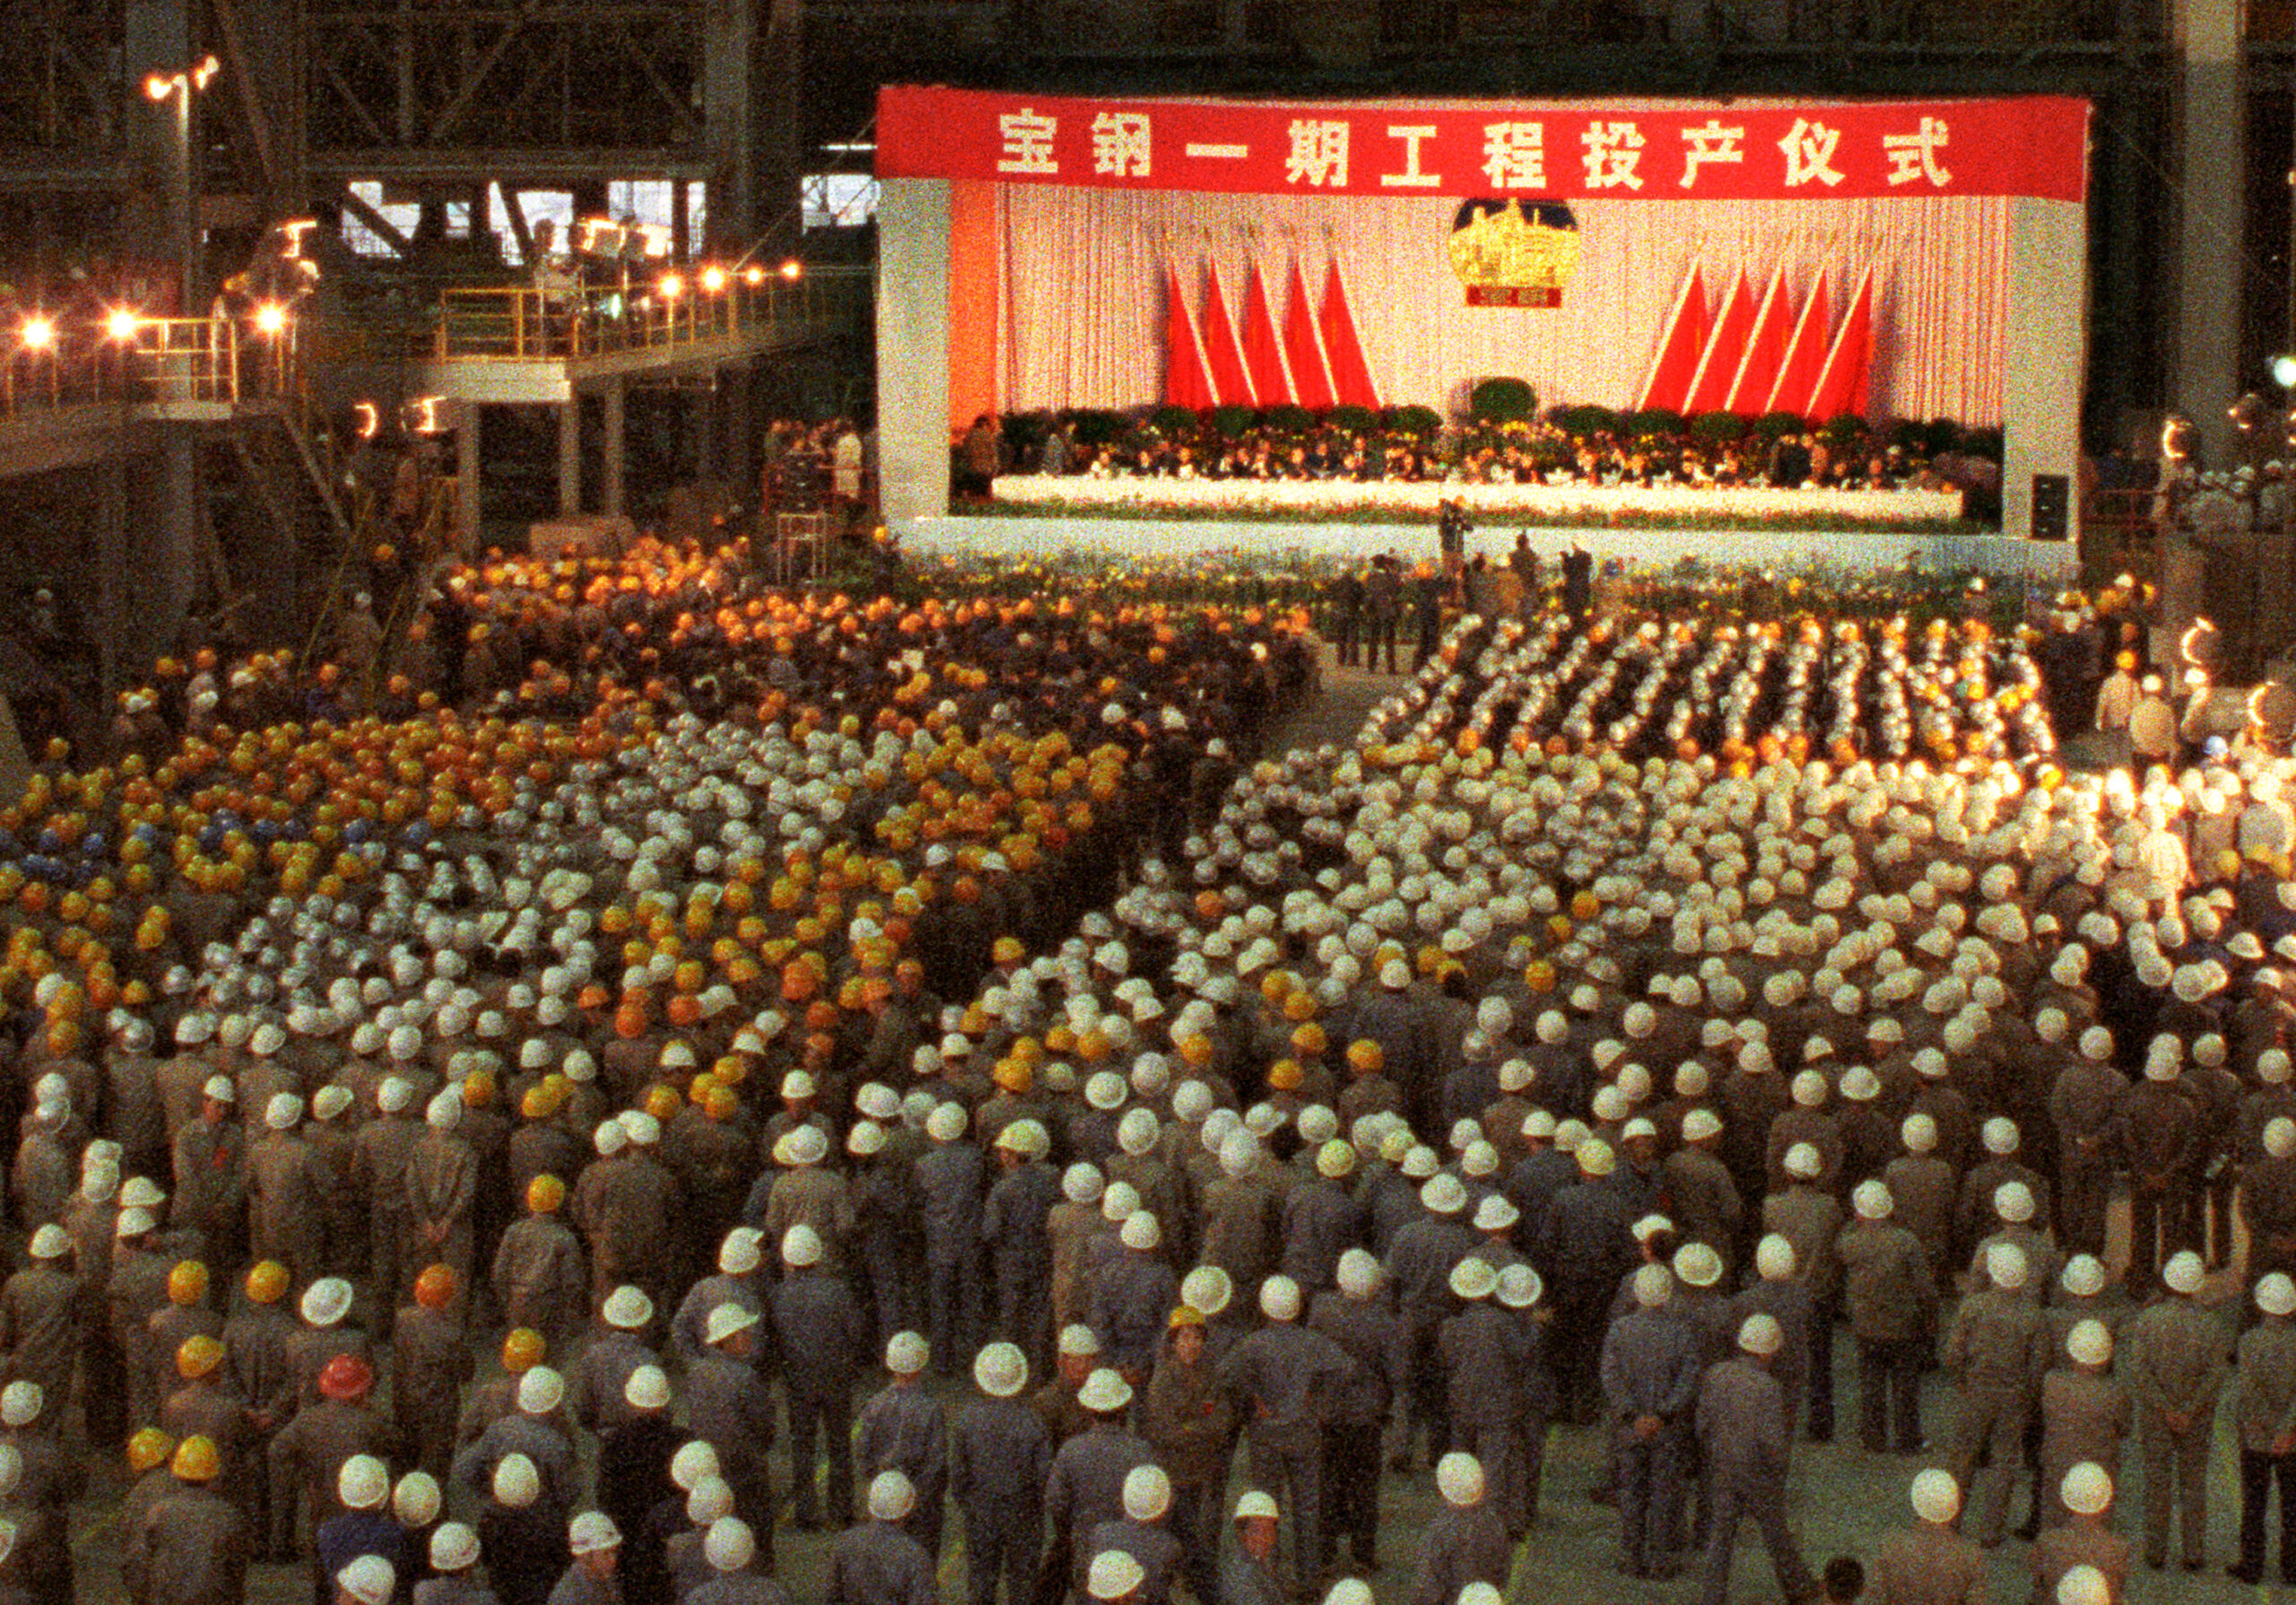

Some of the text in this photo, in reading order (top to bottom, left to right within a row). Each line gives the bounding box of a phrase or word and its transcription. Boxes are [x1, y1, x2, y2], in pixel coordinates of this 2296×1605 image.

[996, 108, 1952, 190] 宝钢一期工程投产仪式
